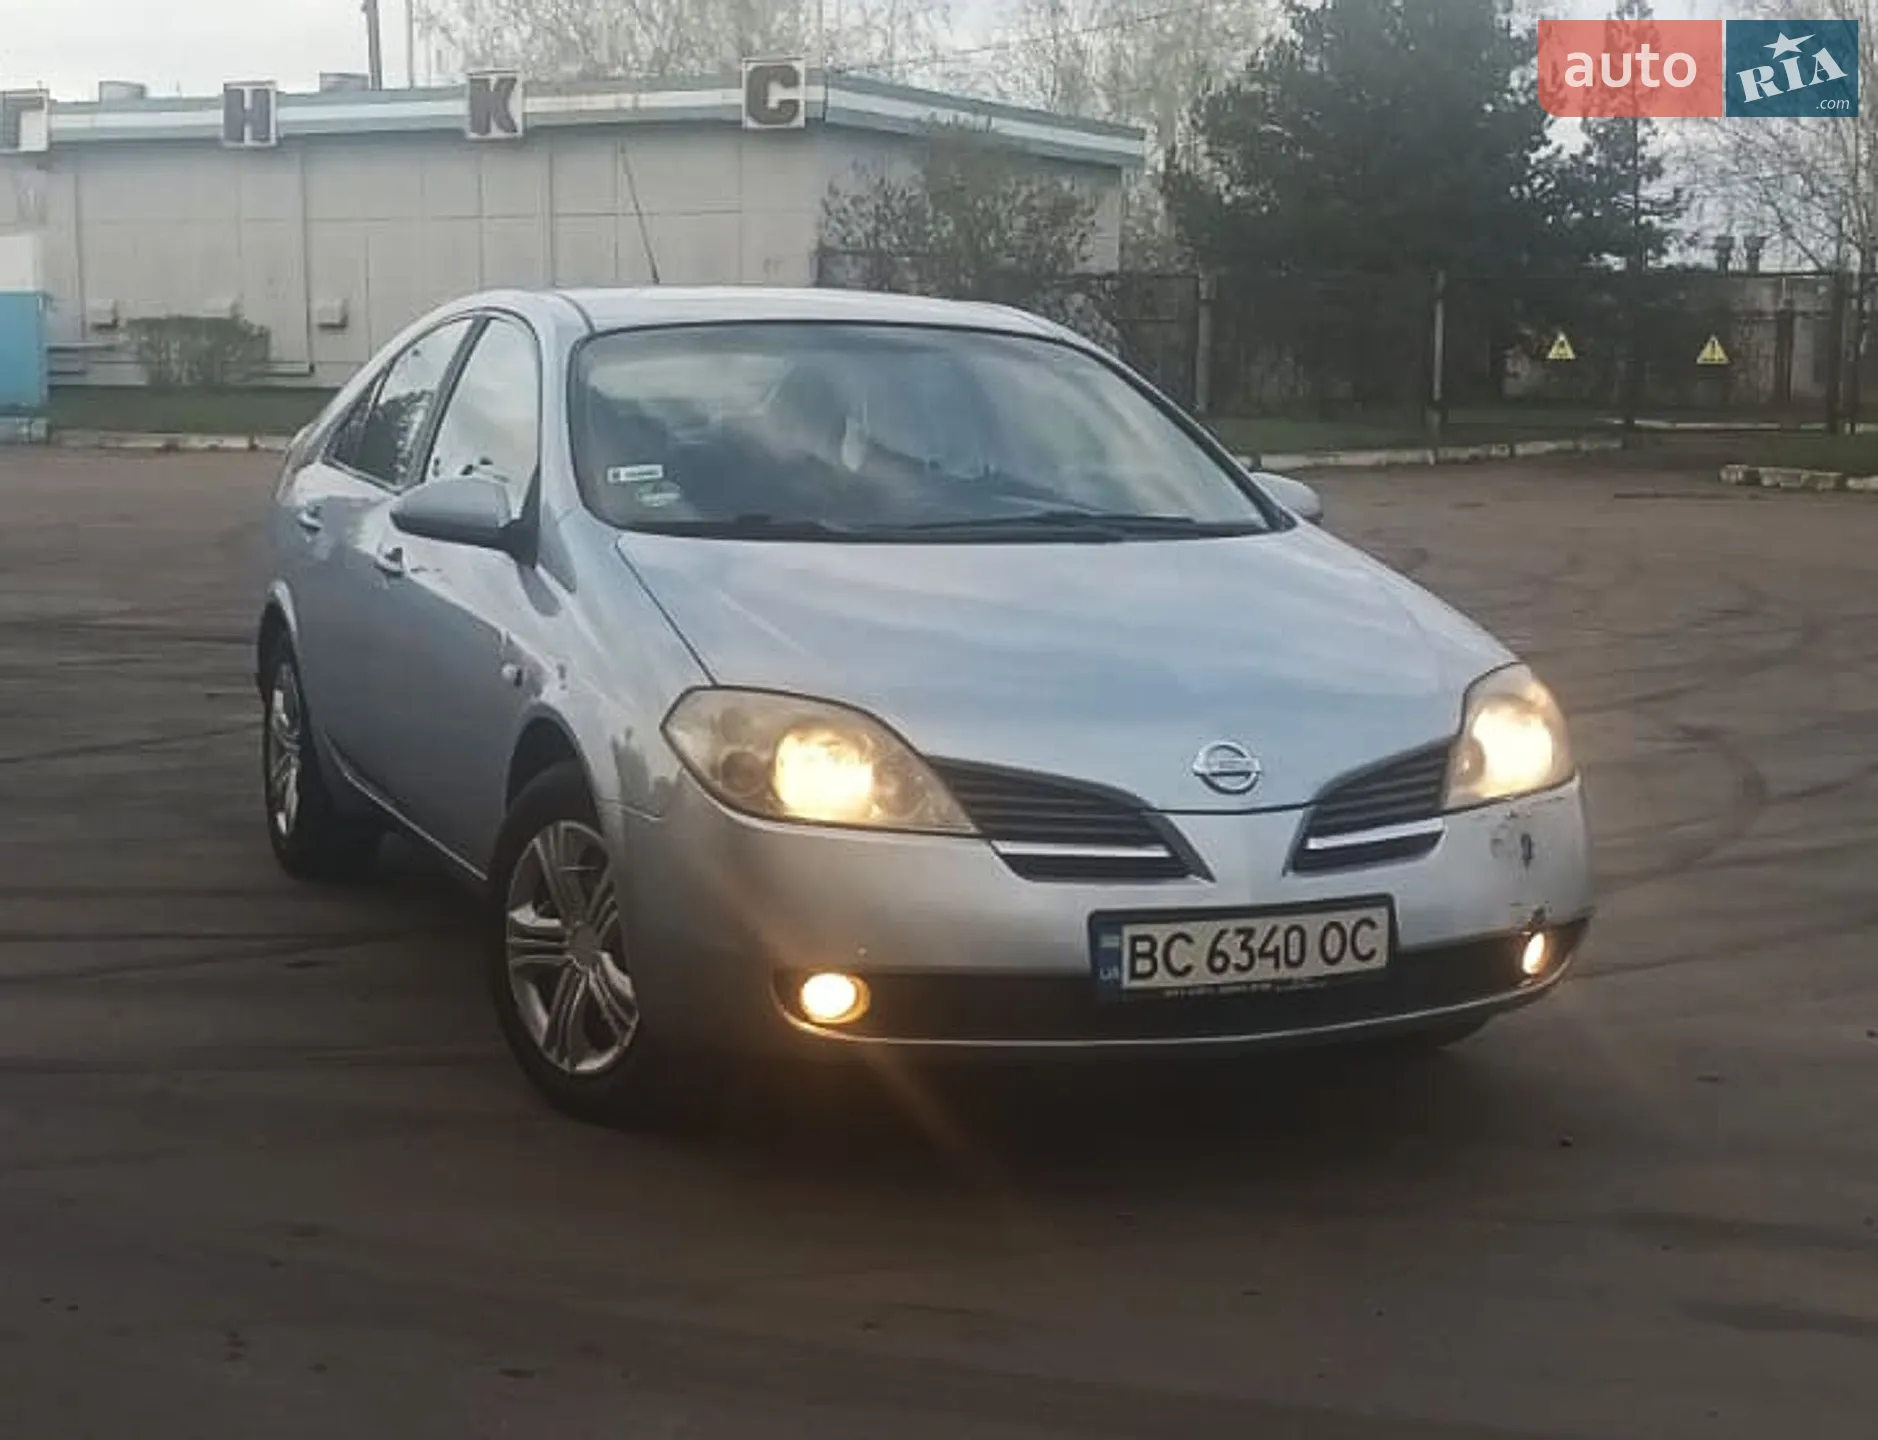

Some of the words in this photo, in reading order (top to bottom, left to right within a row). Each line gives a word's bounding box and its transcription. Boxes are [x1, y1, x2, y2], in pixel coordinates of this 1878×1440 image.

[1128, 932, 1195, 981] BC
[1206, 924, 1307, 976] 6340
[1319, 917, 1378, 967] OC
